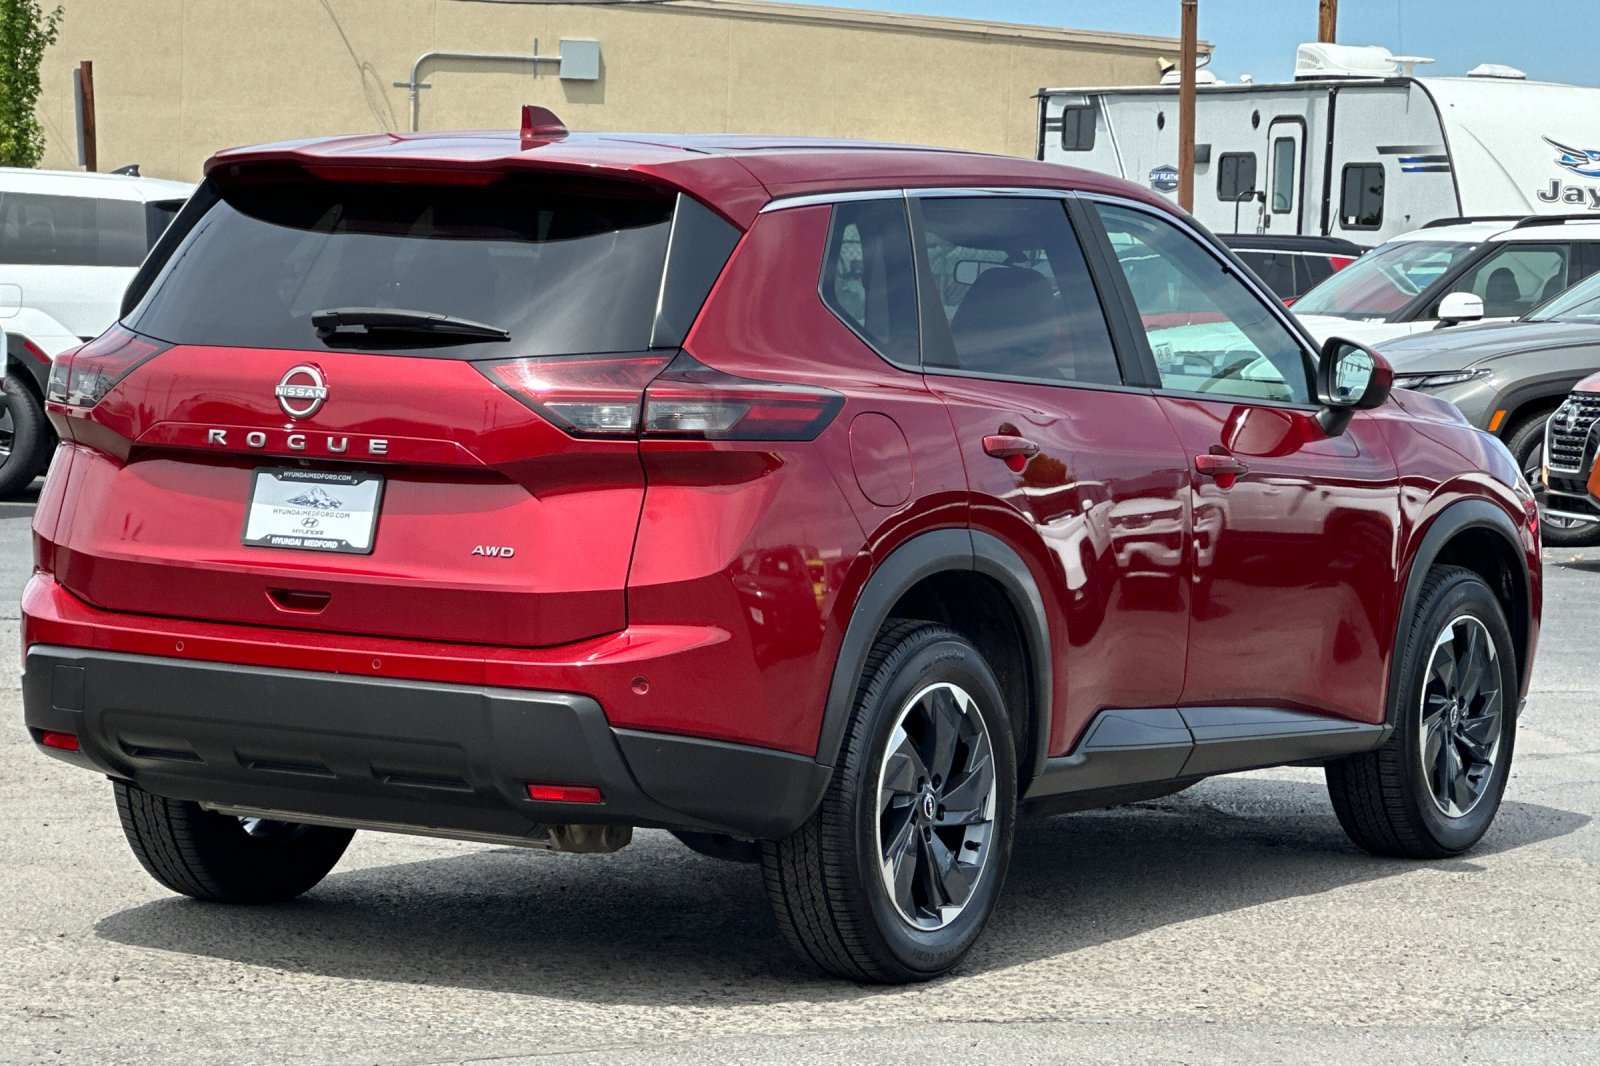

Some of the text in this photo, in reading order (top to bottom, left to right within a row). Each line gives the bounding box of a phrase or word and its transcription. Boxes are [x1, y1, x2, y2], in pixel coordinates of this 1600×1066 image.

[1149, 173, 1159, 181] JAY
[275, 385, 327, 399] NISSAN
[208, 429, 389, 455] ROGUE
[283, 471, 352, 481] HYUNDAIMEDFORD.COM
[273, 508, 350, 518] HYUNDAIMEDFORD.COM
[292, 528, 325, 536] HYUNDAI
[271, 536, 338, 549] HYUNDAI MEDFORD
[471, 544, 515, 559] AWD
